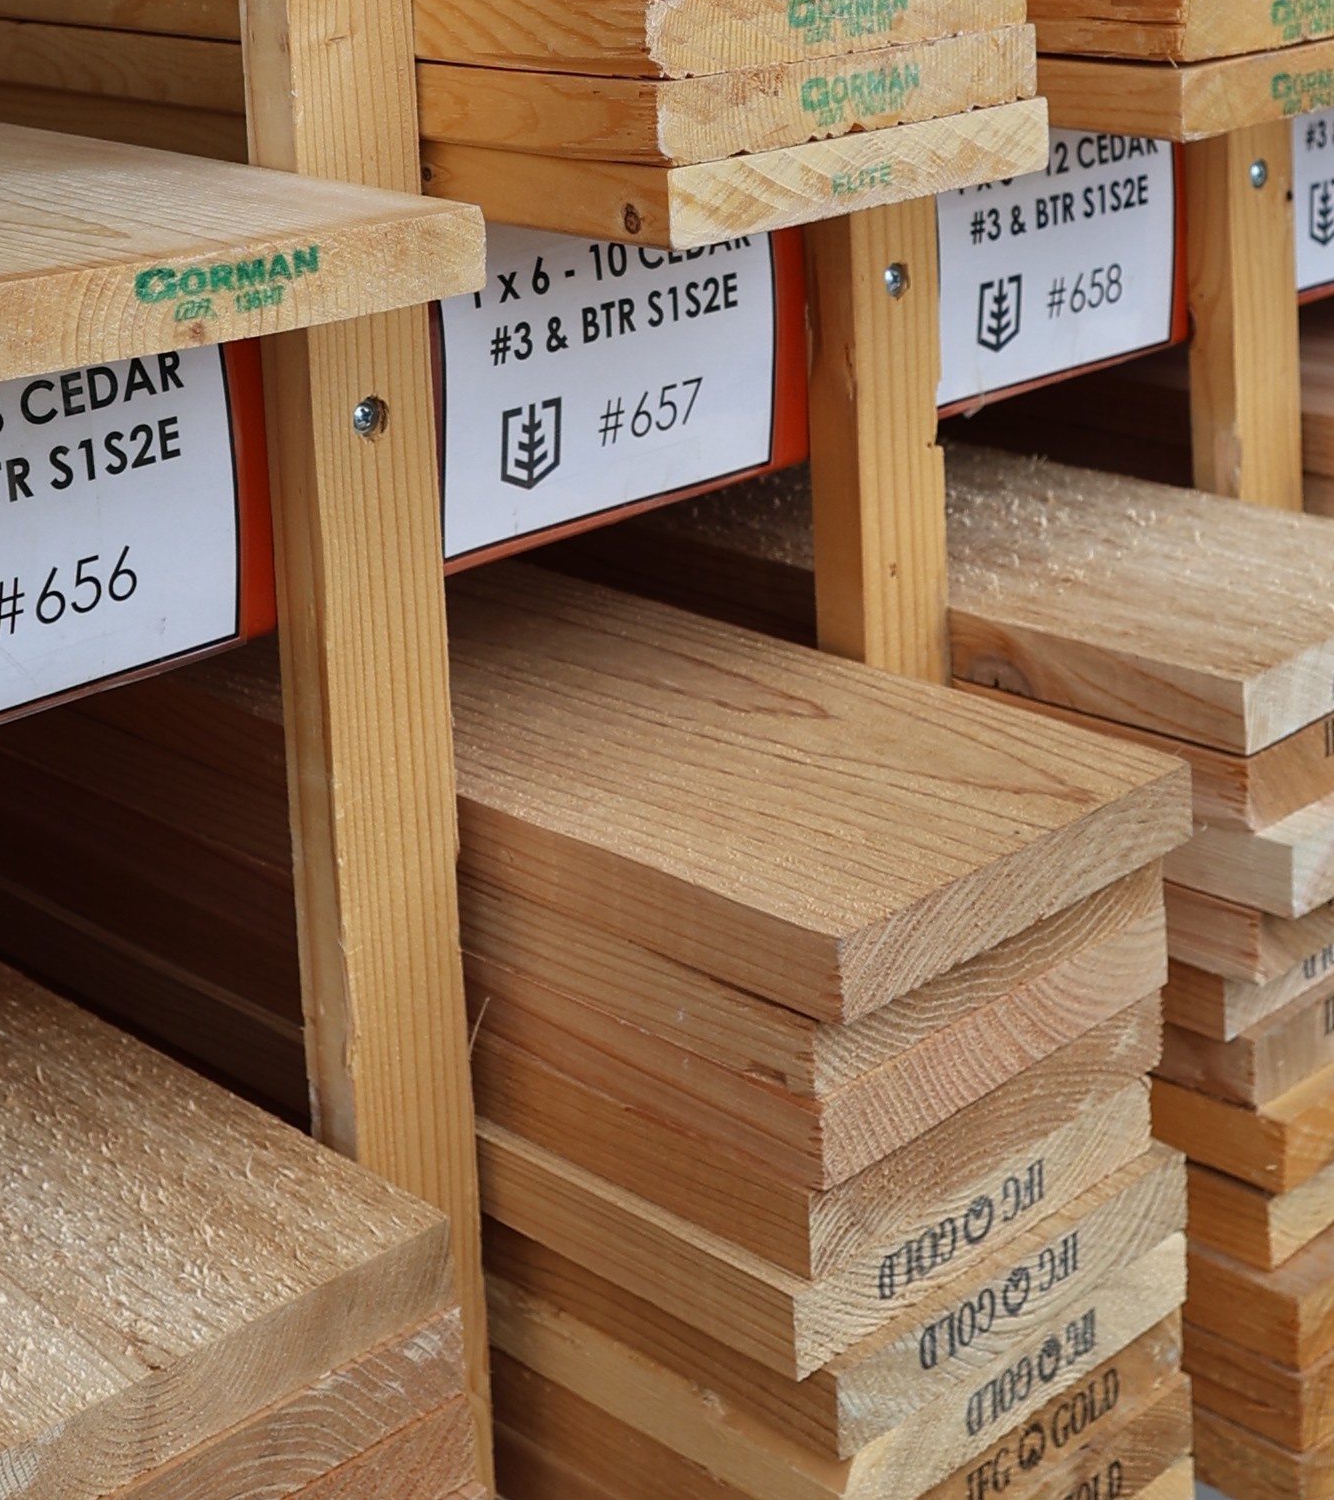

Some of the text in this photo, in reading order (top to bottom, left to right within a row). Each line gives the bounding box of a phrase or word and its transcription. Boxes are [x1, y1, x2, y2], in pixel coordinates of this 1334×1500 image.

[801, 63, 921, 113] GORMAN
[1077, 134, 1159, 170] CEDAR
[1305, 119, 1327, 151] #3
[970, 174, 1149, 244] #3 & BTR S1S2E
[133, 244, 321, 304] GORMAN
[497, 272, 521, 304] x
[531, 256, 550, 295] 6
[588, 243, 628, 282] 10
[1047, 263, 1122, 320] #658
[490, 271, 738, 366] #3 & BTR S1S2E
[20, 351, 186, 426] CEDAR
[597, 376, 704, 448] #657
[49, 416, 182, 490] S1S2E
[919, 1229, 1081, 1371] IFG GOLD
[1051, 1367, 1121, 1451] GOLD
